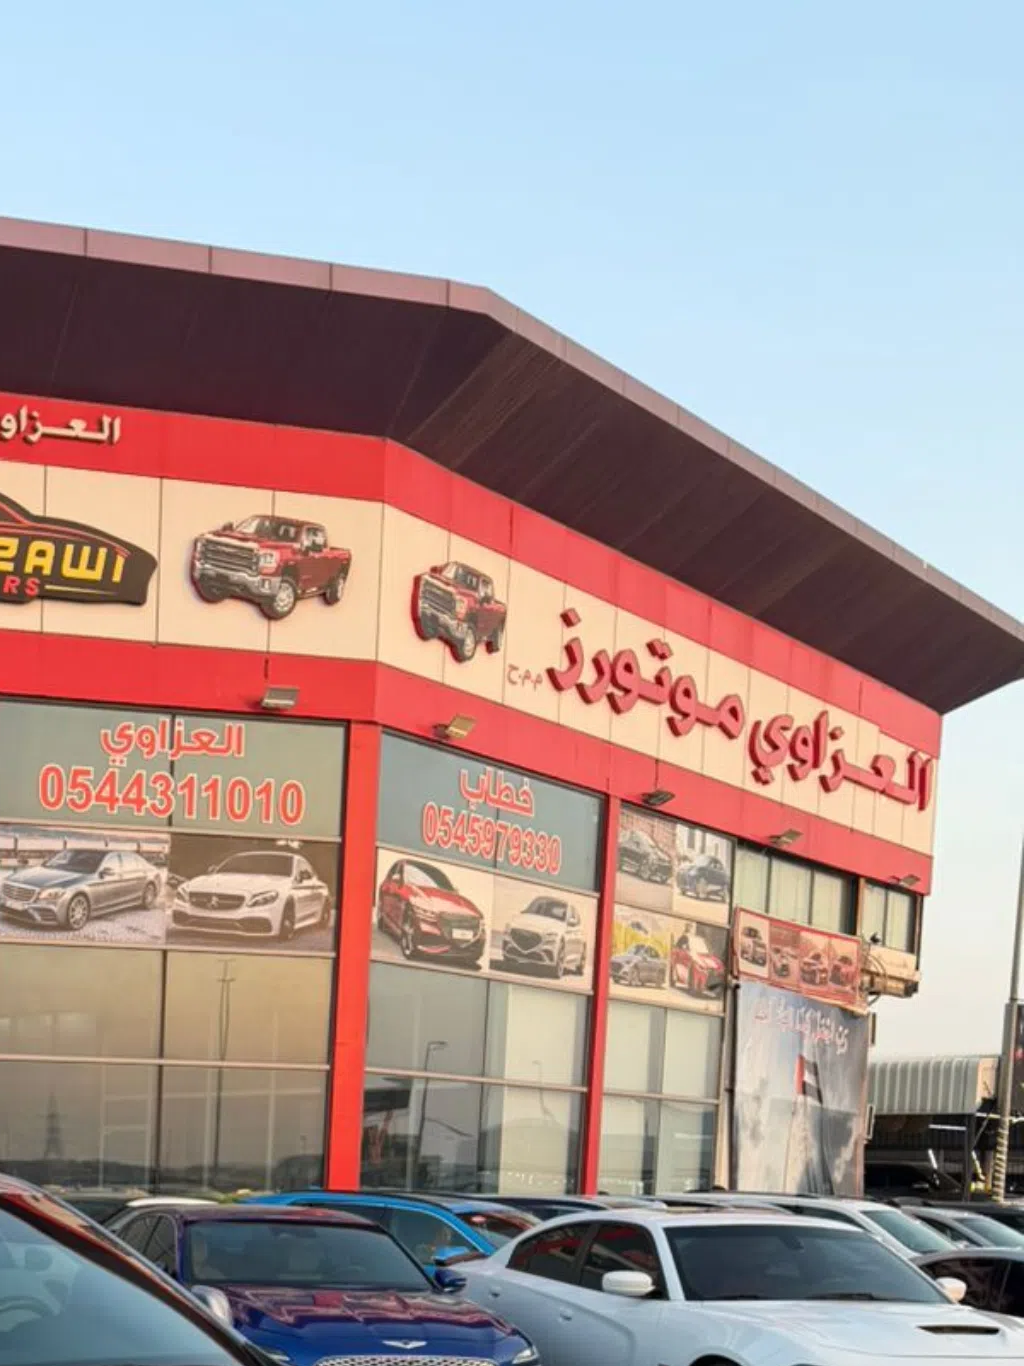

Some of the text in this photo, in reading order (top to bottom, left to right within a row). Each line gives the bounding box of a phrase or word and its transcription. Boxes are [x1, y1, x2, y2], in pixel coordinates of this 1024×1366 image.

[546, 607, 746, 740] موتورز
[100, 718, 245, 766] العزاوي
[748, 708, 934, 812] العزاوي
[39, 764, 305, 825] 0544311010
[459, 766, 534, 816] خطاب
[420, 801, 562, 875] 0545979330
